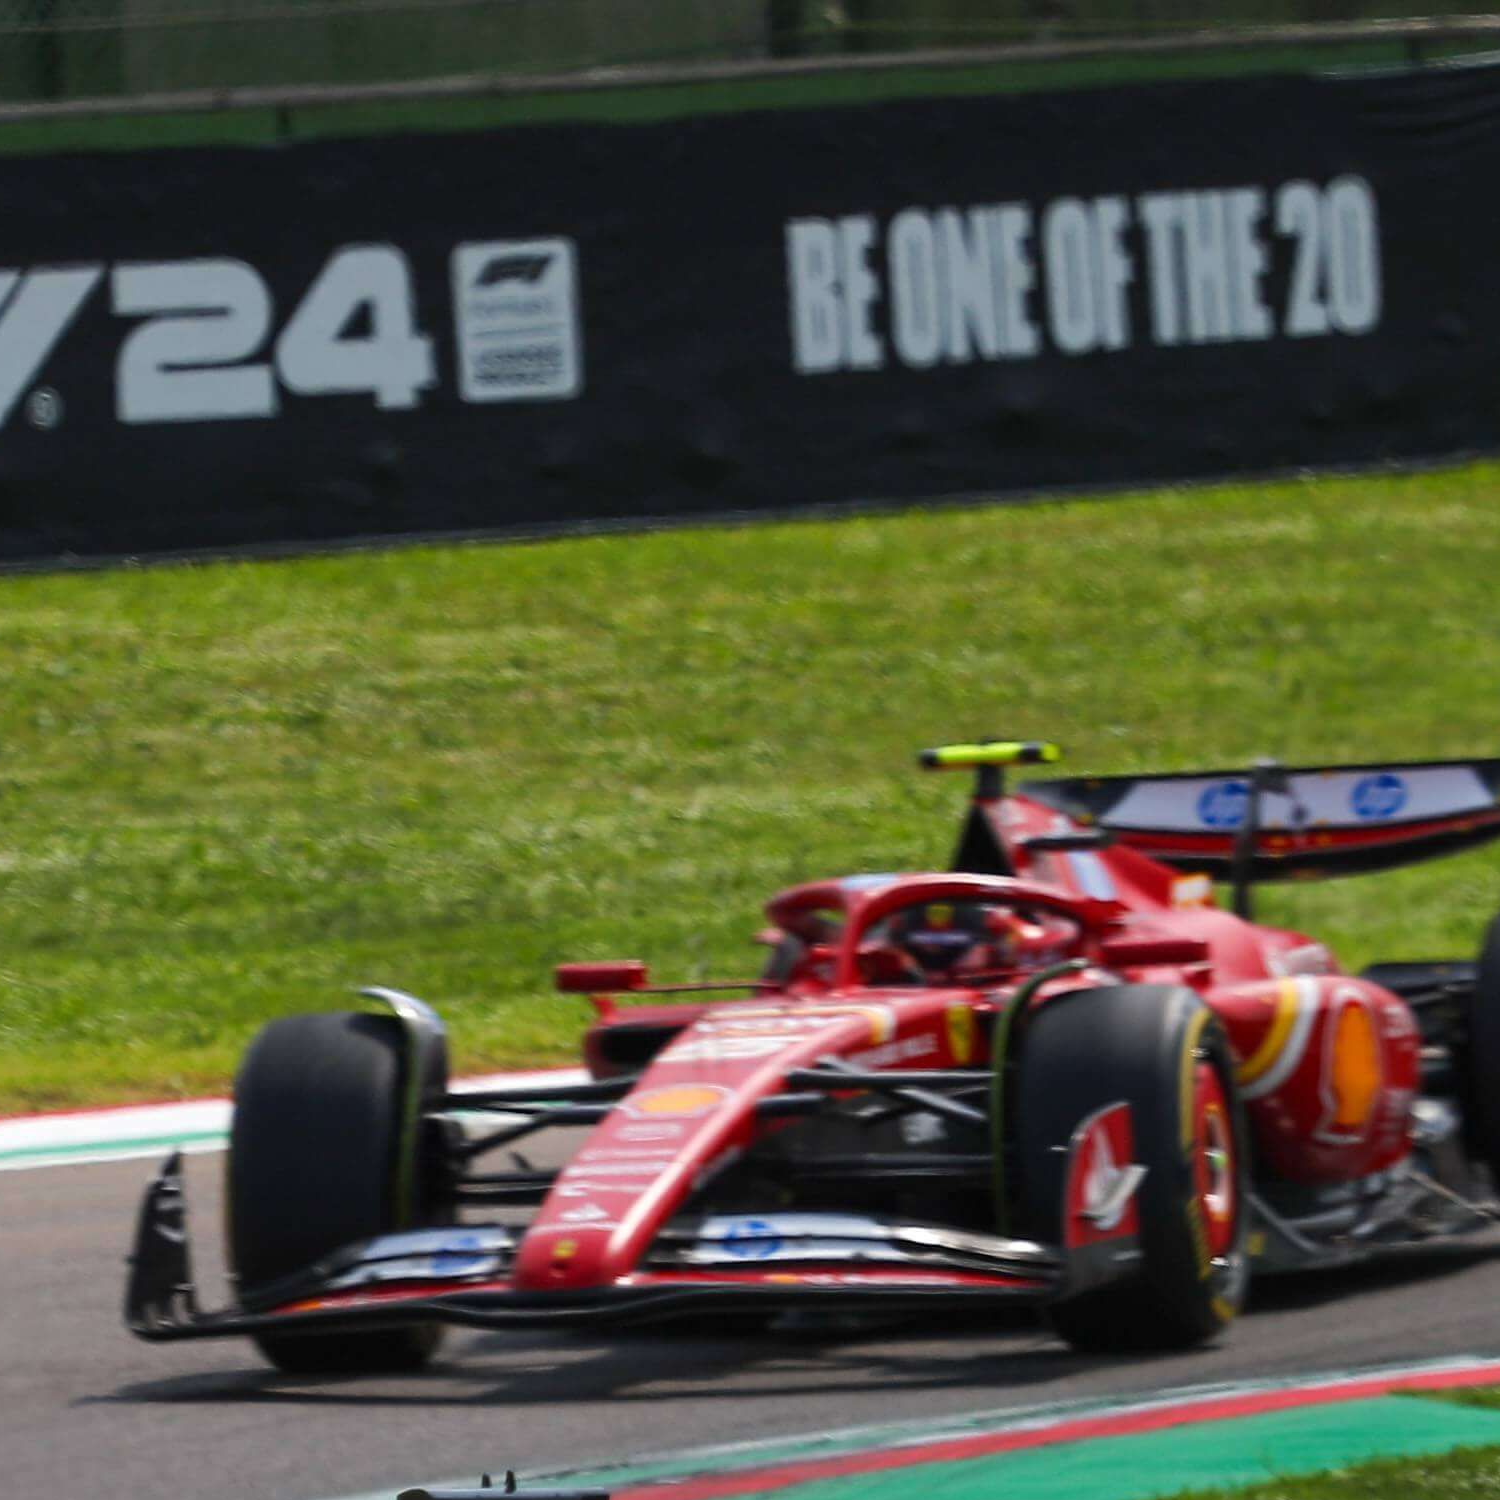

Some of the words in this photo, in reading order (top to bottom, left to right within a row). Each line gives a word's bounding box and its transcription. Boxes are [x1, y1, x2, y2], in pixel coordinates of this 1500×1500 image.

[112, 242, 437, 423] 24
[786, 216, 884, 375] BE
[888, 203, 1040, 367] ONE
[1043, 196, 1132, 354] OF
[1137, 186, 1273, 346] THE
[1278, 175, 1382, 336] 20
